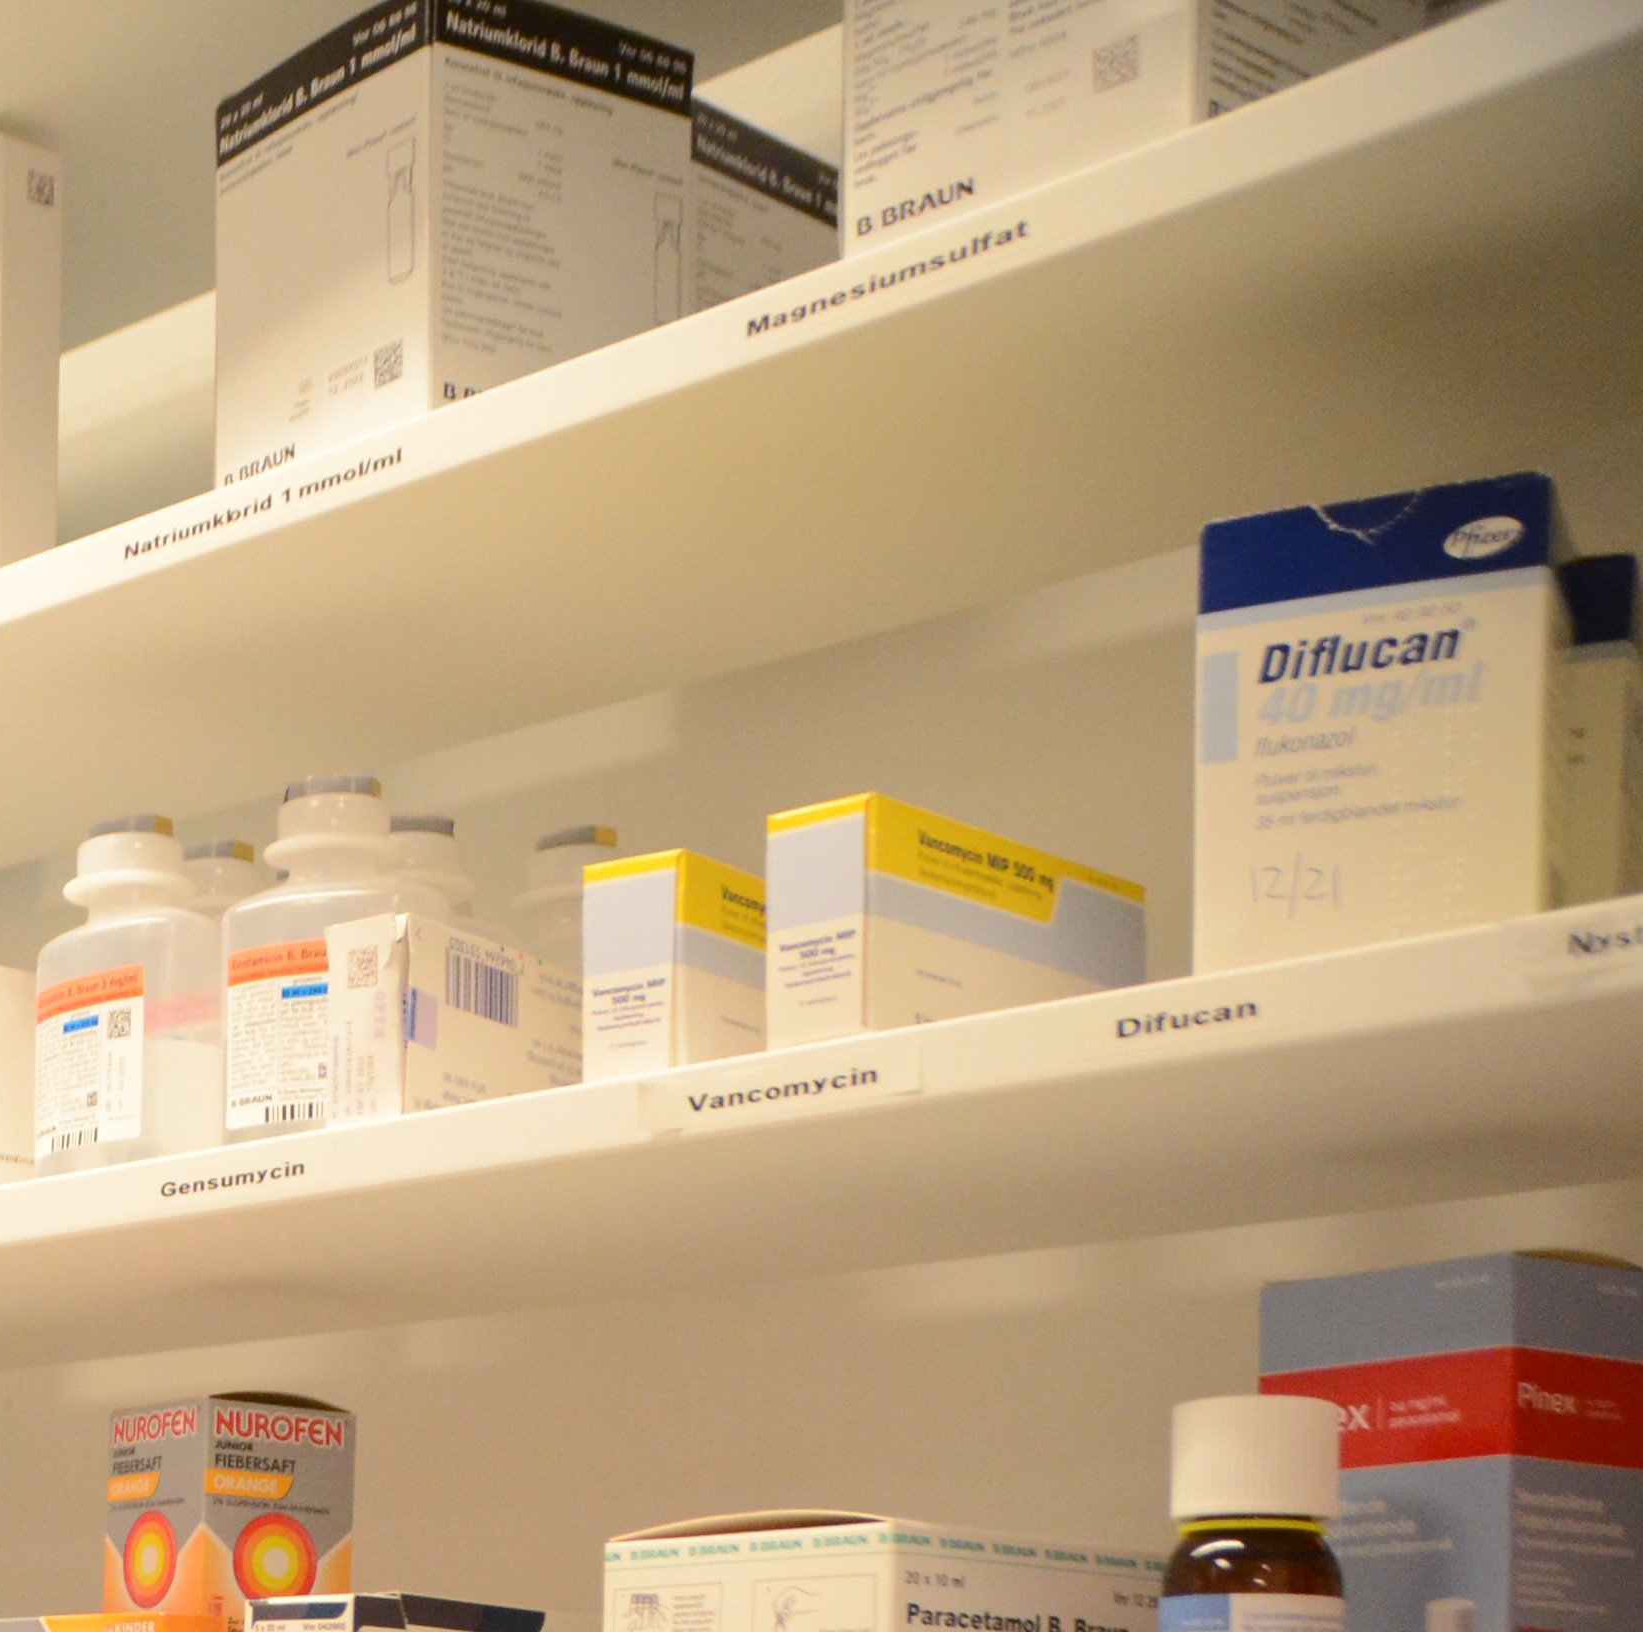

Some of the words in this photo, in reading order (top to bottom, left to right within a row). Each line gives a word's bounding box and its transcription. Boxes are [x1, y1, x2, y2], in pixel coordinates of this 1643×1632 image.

[445, 9, 548, 59] Natriumklorid
[551, 40, 565, 65] B.
[569, 47, 610, 79] Braun
[614, 61, 621, 80] 1
[881, 177, 976, 228] BRAUN
[746, 221, 1029, 337] Magnesiumsulfat
[238, 443, 296, 481] BRAUN
[281, 487, 292, 504] 1
[299, 448, 402, 499] mmol/ml
[1257, 628, 1462, 685] Diflucan
[1257, 682, 1318, 727] 40
[918, 829, 983, 866] Vancomycin
[1038, 872, 1055, 894] mg
[688, 1066, 880, 1112] Vancomycin
[160, 1160, 307, 1200] Gensumycin
[1516, 1380, 1578, 1416] Pinex
[113, 1406, 199, 1445] NUROFEN
[215, 1408, 345, 1448] NUROFEN
[112, 1455, 163, 1476] FIEBERSAFT
[214, 1452, 297, 1475] FIEBERSAFT
[215, 1440, 254, 1452] JUNIOR
[111, 1478, 152, 1496] ORANGE
[214, 1475, 279, 1495] ORANGE
